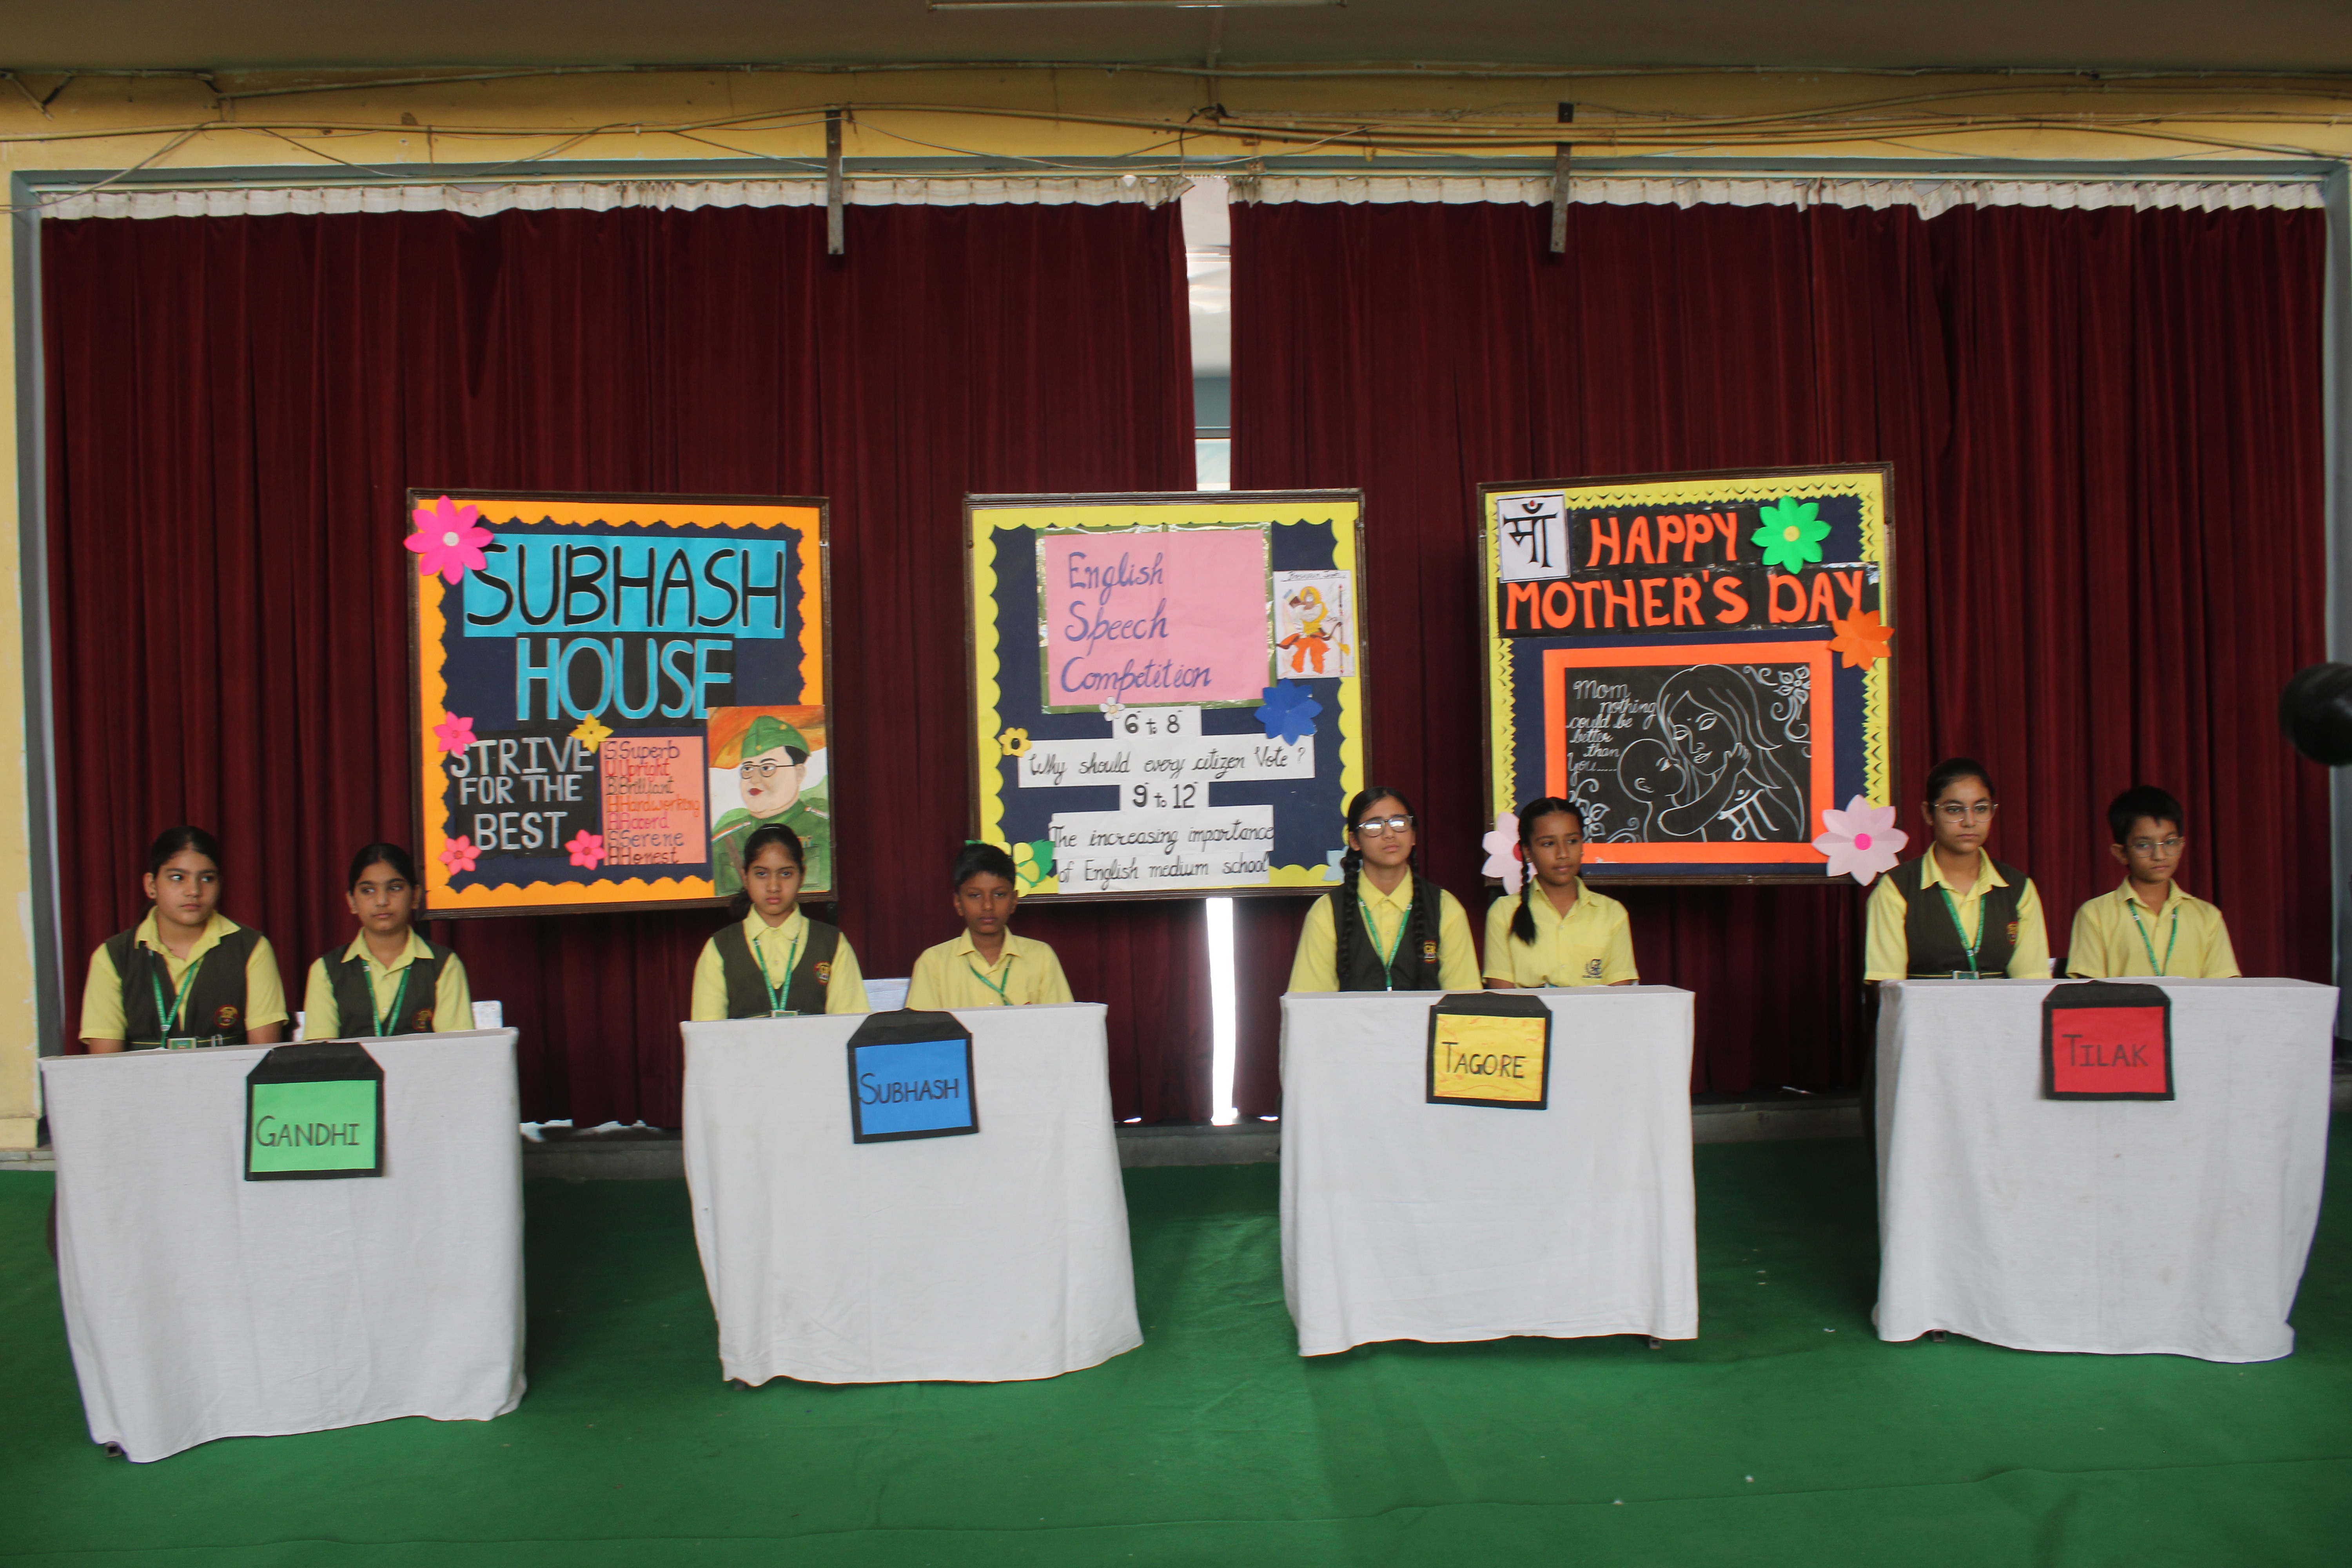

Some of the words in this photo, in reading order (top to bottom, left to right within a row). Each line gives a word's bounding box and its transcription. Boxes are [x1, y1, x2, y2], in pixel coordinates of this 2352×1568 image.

[1503, 499, 1558, 568] माँ
[1585, 512, 1738, 567] HAPPY
[466, 543, 784, 629] SUBHASH
[1069, 551, 1163, 606] English
[1505, 570, 1749, 630] MOTHER'S
[1768, 570, 1864, 624] DAY
[1065, 597, 1169, 656] Speech
[516, 637, 733, 721] HOUSE
[1061, 656, 1212, 704] Competition
[1573, 680, 1632, 699] Mom
[1125, 713, 1139, 734] 6
[1145, 718, 1157, 735] to
[1167, 714, 1180, 733] 8
[1565, 713, 1611, 729] could
[1612, 713, 1633, 729] be
[1599, 697, 1657, 730] nothing
[619, 740, 680, 764] Superb
[1569, 728, 1614, 743] better
[1583, 743, 1620, 757] than
[450, 736, 595, 778] STRIVE
[1028, 753, 1068, 785] Why
[1078, 751, 1131, 774] should
[1144, 758, 1186, 779] every
[1191, 747, 1245, 779] citizen
[459, 776, 515, 805] FOR
[520, 774, 583, 802] THE
[1132, 784, 1147, 808] 9
[1153, 792, 1167, 808] to
[1172, 784, 1195, 809] 12
[474, 811, 568, 851] BEST
[1717, 788, 1780, 840] माँ
[619, 829, 684, 848] Serene
[1049, 825, 1077, 848] The
[1088, 829, 1179, 855] increasing
[1187, 818, 1274, 853] importance
[1059, 860, 1074, 883] of
[1085, 857, 1140, 890] English
[1148, 855, 1209, 878] medium
[1222, 851, 1270, 874] school
[1441, 1042, 1526, 1079] TAGORE
[2062, 1034, 2149, 1067] TILAK
[858, 1073, 959, 1105] SUBHASH
[256, 1115, 360, 1147] GANDHI
